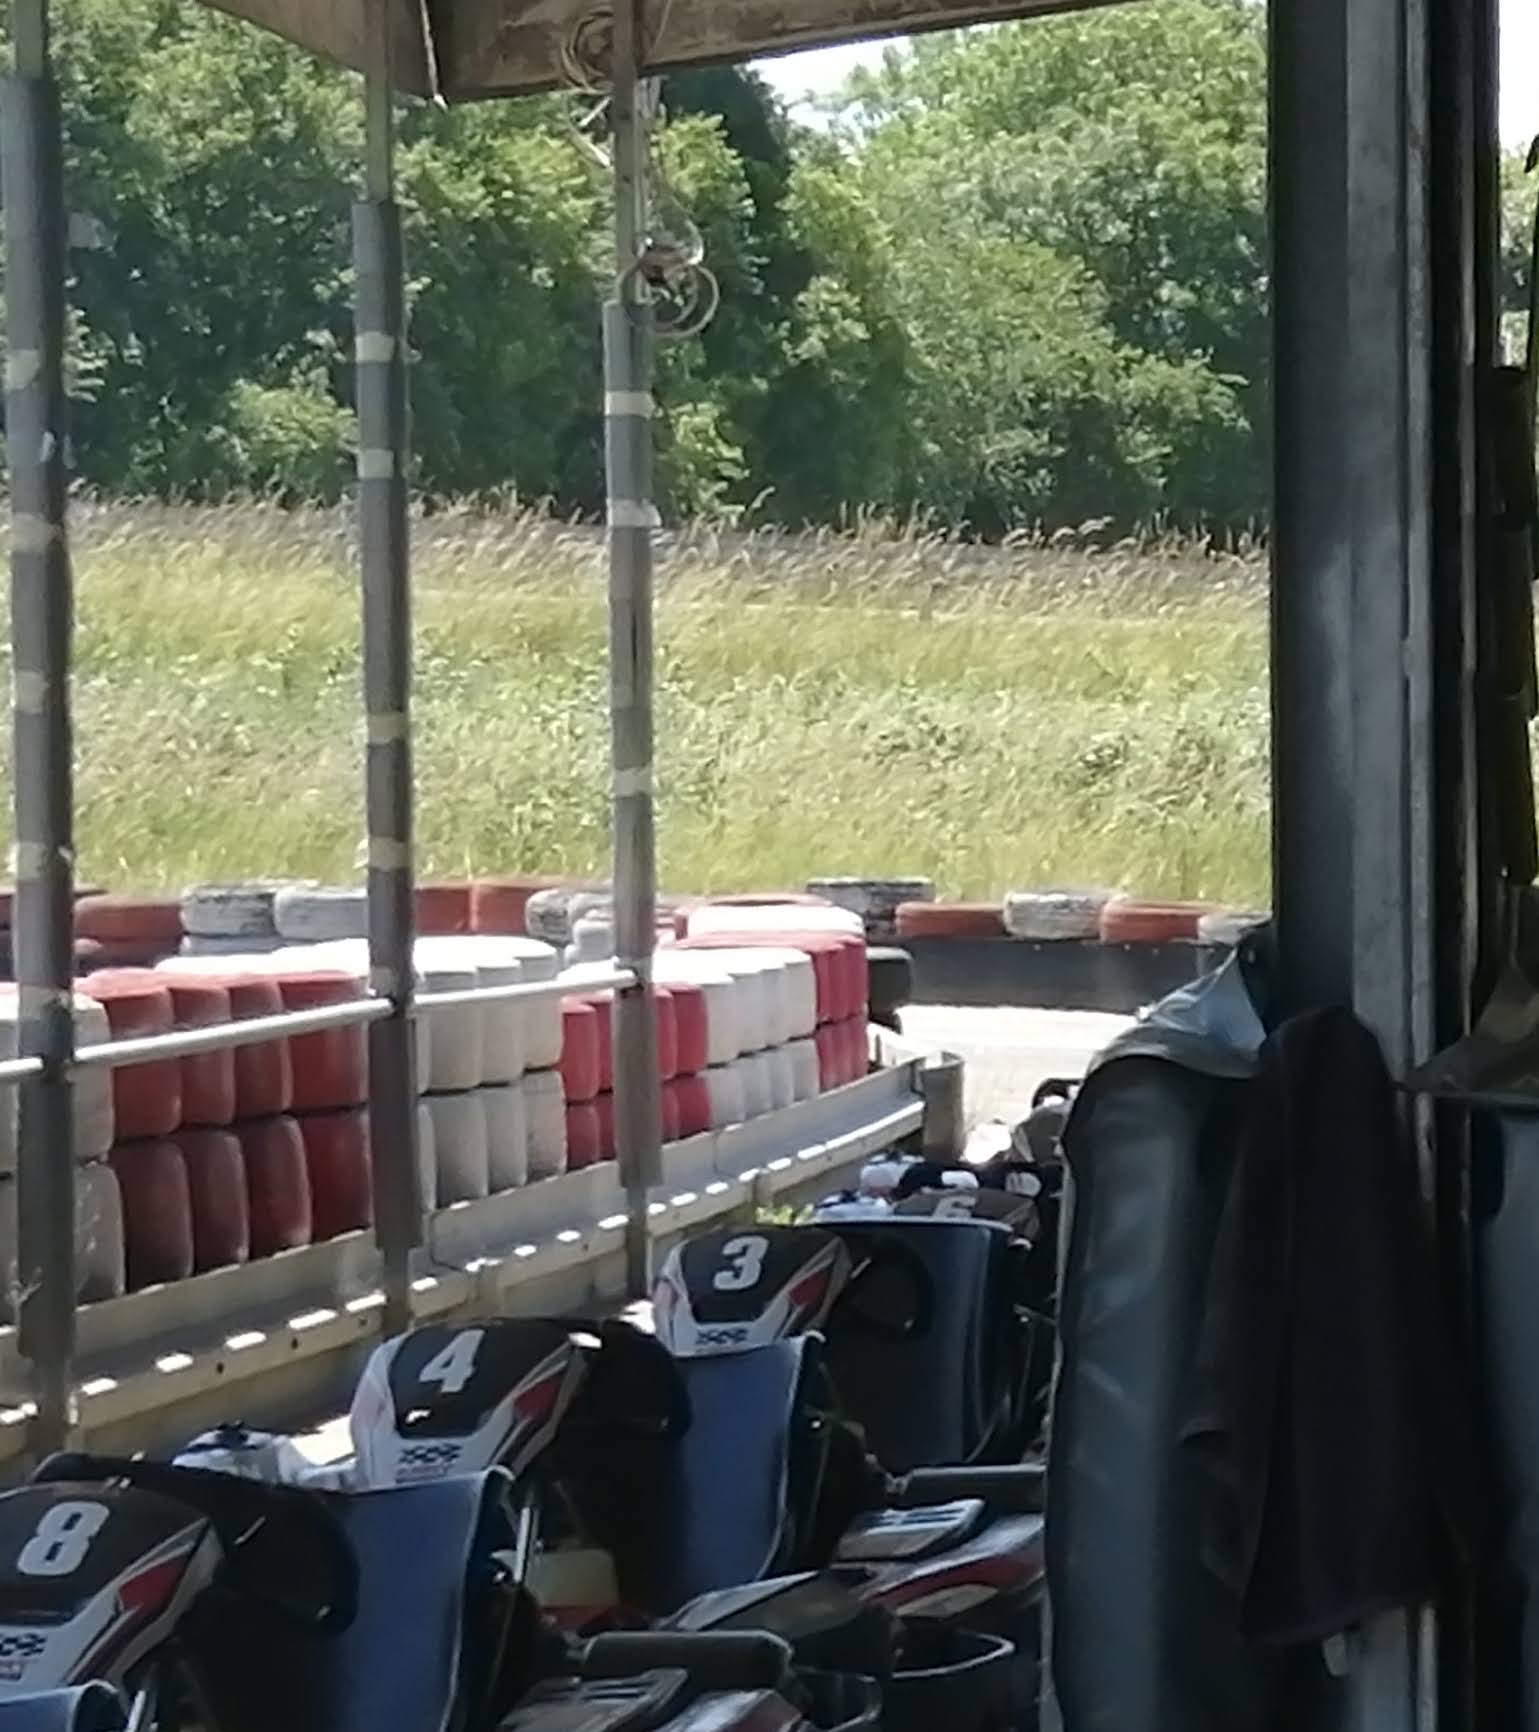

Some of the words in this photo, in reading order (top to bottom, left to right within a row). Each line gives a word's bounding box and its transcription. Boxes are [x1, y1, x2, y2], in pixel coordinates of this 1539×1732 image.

[712, 1234, 770, 1291] 3
[418, 1328, 486, 1393] 4
[17, 1501, 111, 1576] 8
